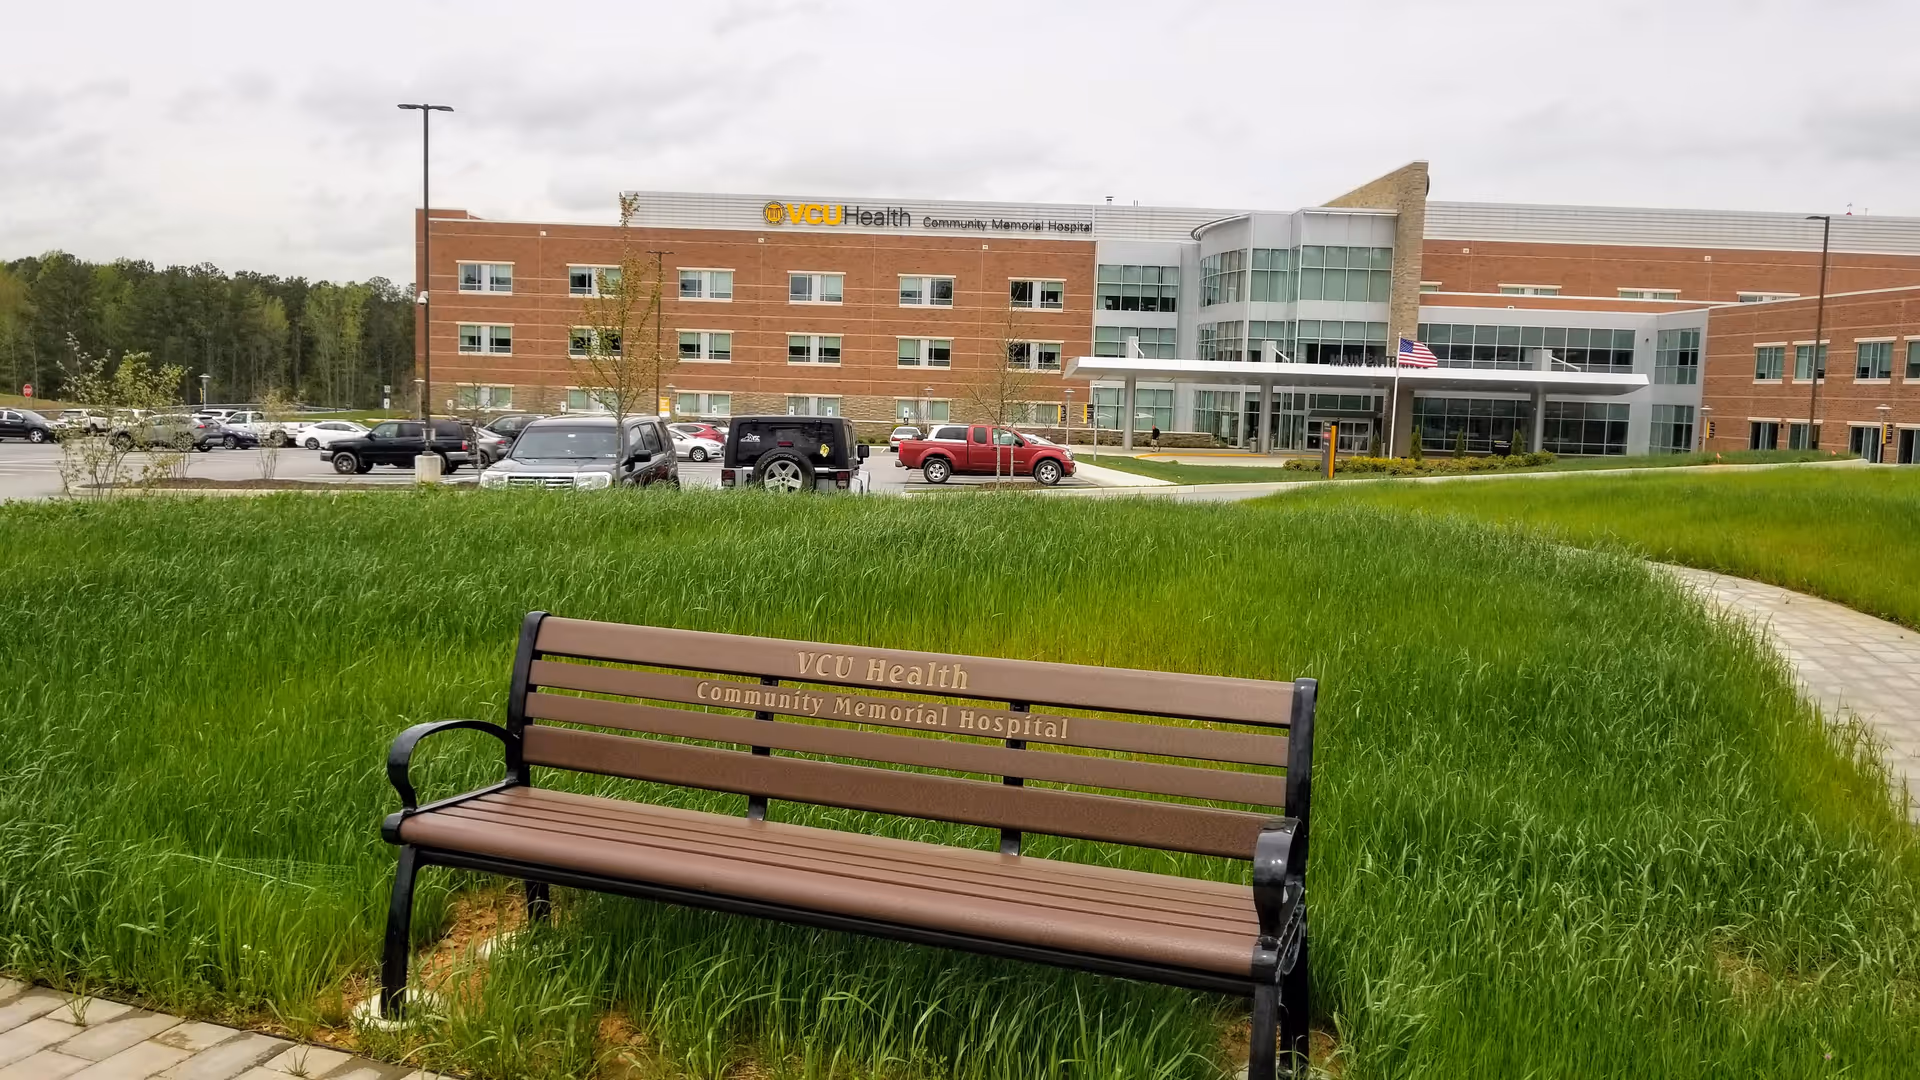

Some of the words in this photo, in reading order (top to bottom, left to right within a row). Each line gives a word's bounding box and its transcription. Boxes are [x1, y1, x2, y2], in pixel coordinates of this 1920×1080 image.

[923, 216, 987, 231] Community
[991, 218, 1043, 231] Memorial
[1048, 219, 1092, 234] Hospital
[797, 651, 854, 679] VCU
[867, 657, 969, 690] Health
[696, 681, 824, 717] Community
[833, 696, 948, 727] Memorial
[959, 710, 1069, 740] Hospital
